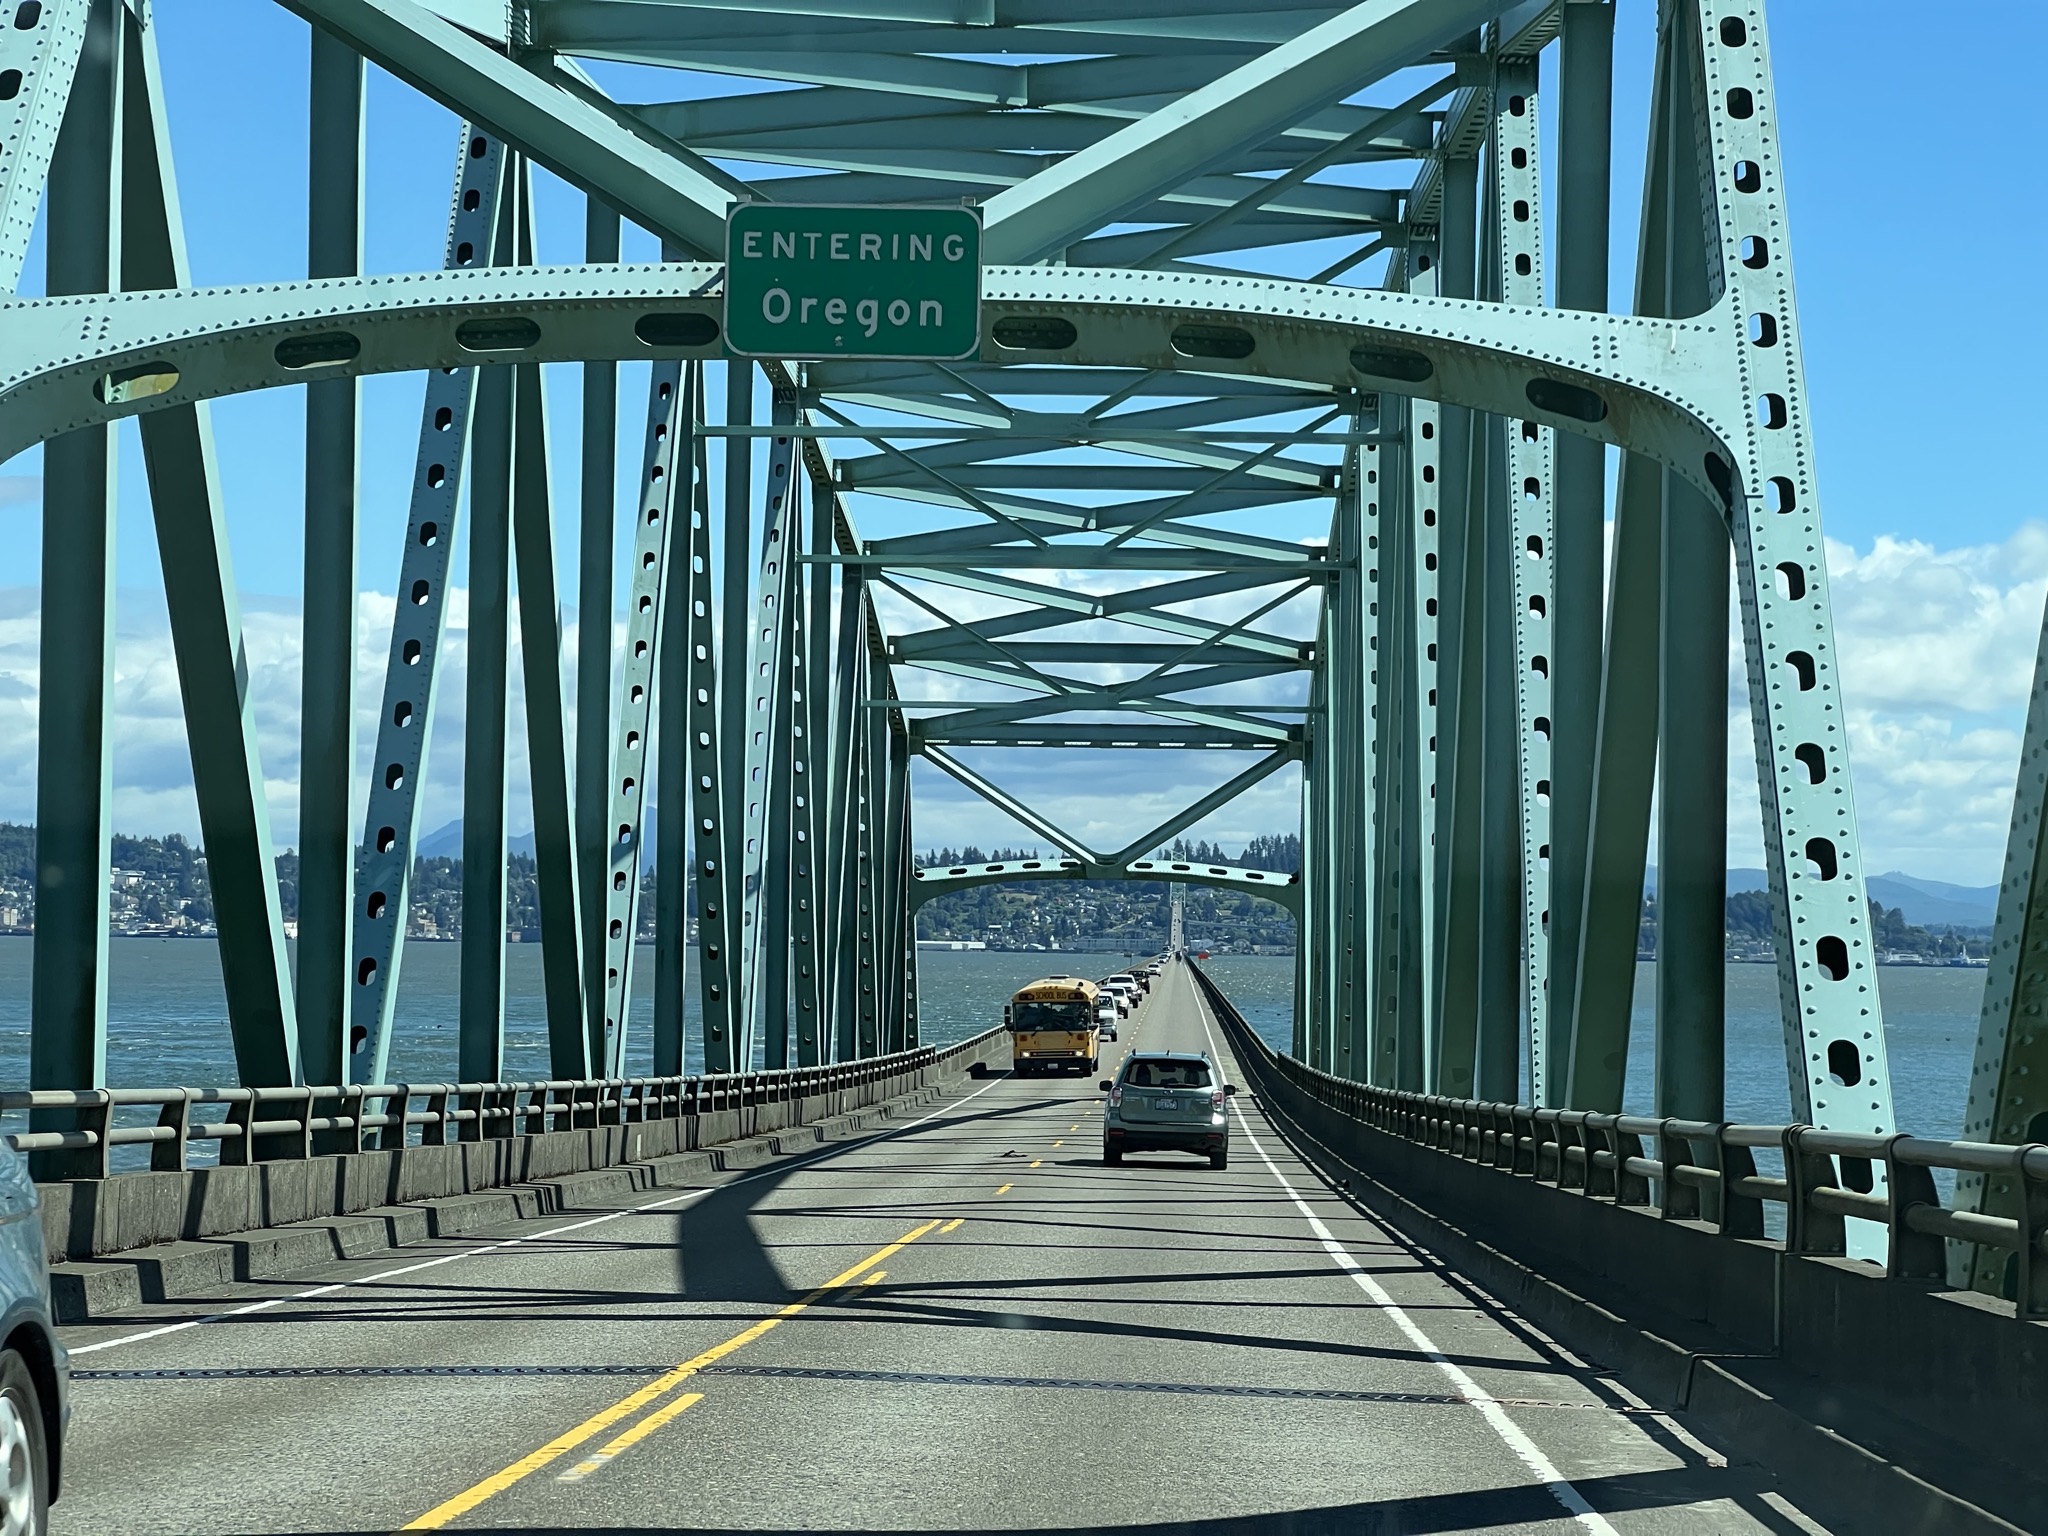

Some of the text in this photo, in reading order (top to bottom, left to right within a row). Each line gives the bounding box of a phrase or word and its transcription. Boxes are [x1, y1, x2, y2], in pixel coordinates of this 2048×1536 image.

[743, 231, 964, 262] ENTERING
[762, 287, 943, 338] Oregon
[1035, 991, 1067, 1000] SCHOOL BUS
